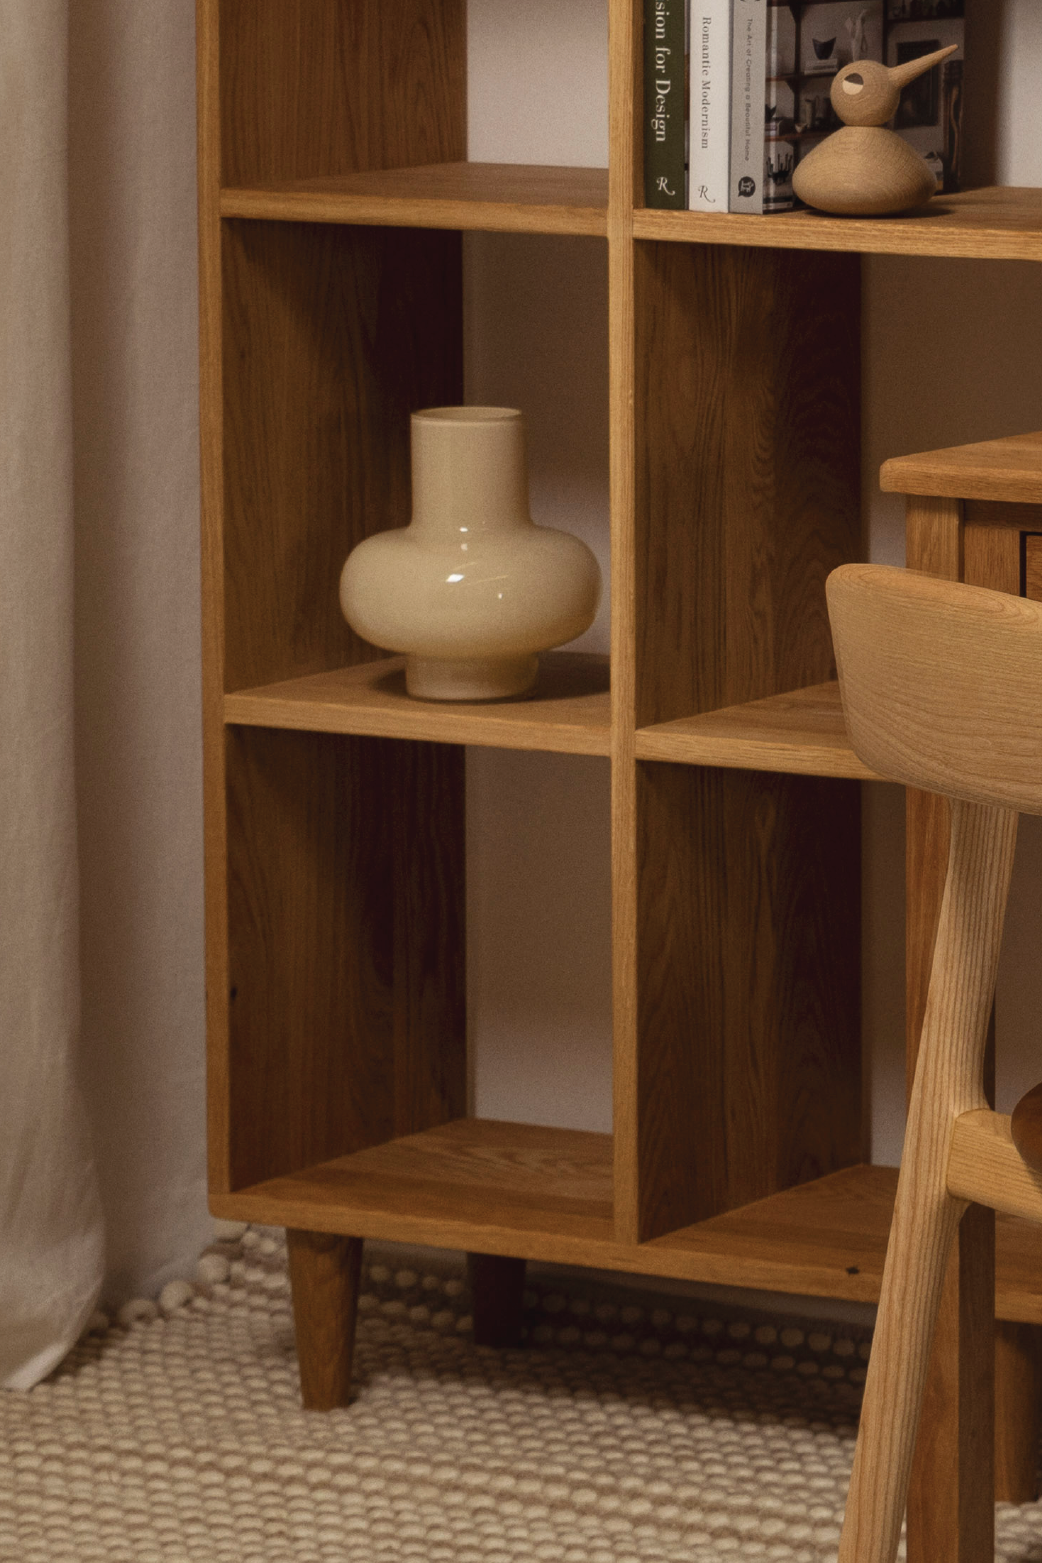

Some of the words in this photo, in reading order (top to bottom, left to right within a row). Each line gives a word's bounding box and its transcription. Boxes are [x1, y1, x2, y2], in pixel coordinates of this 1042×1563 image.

[655, 45, 671, 74] for
[701, 16, 712, 76] Romantic
[651, 77, 671, 142] Design
[700, 79, 711, 149] Modernism
